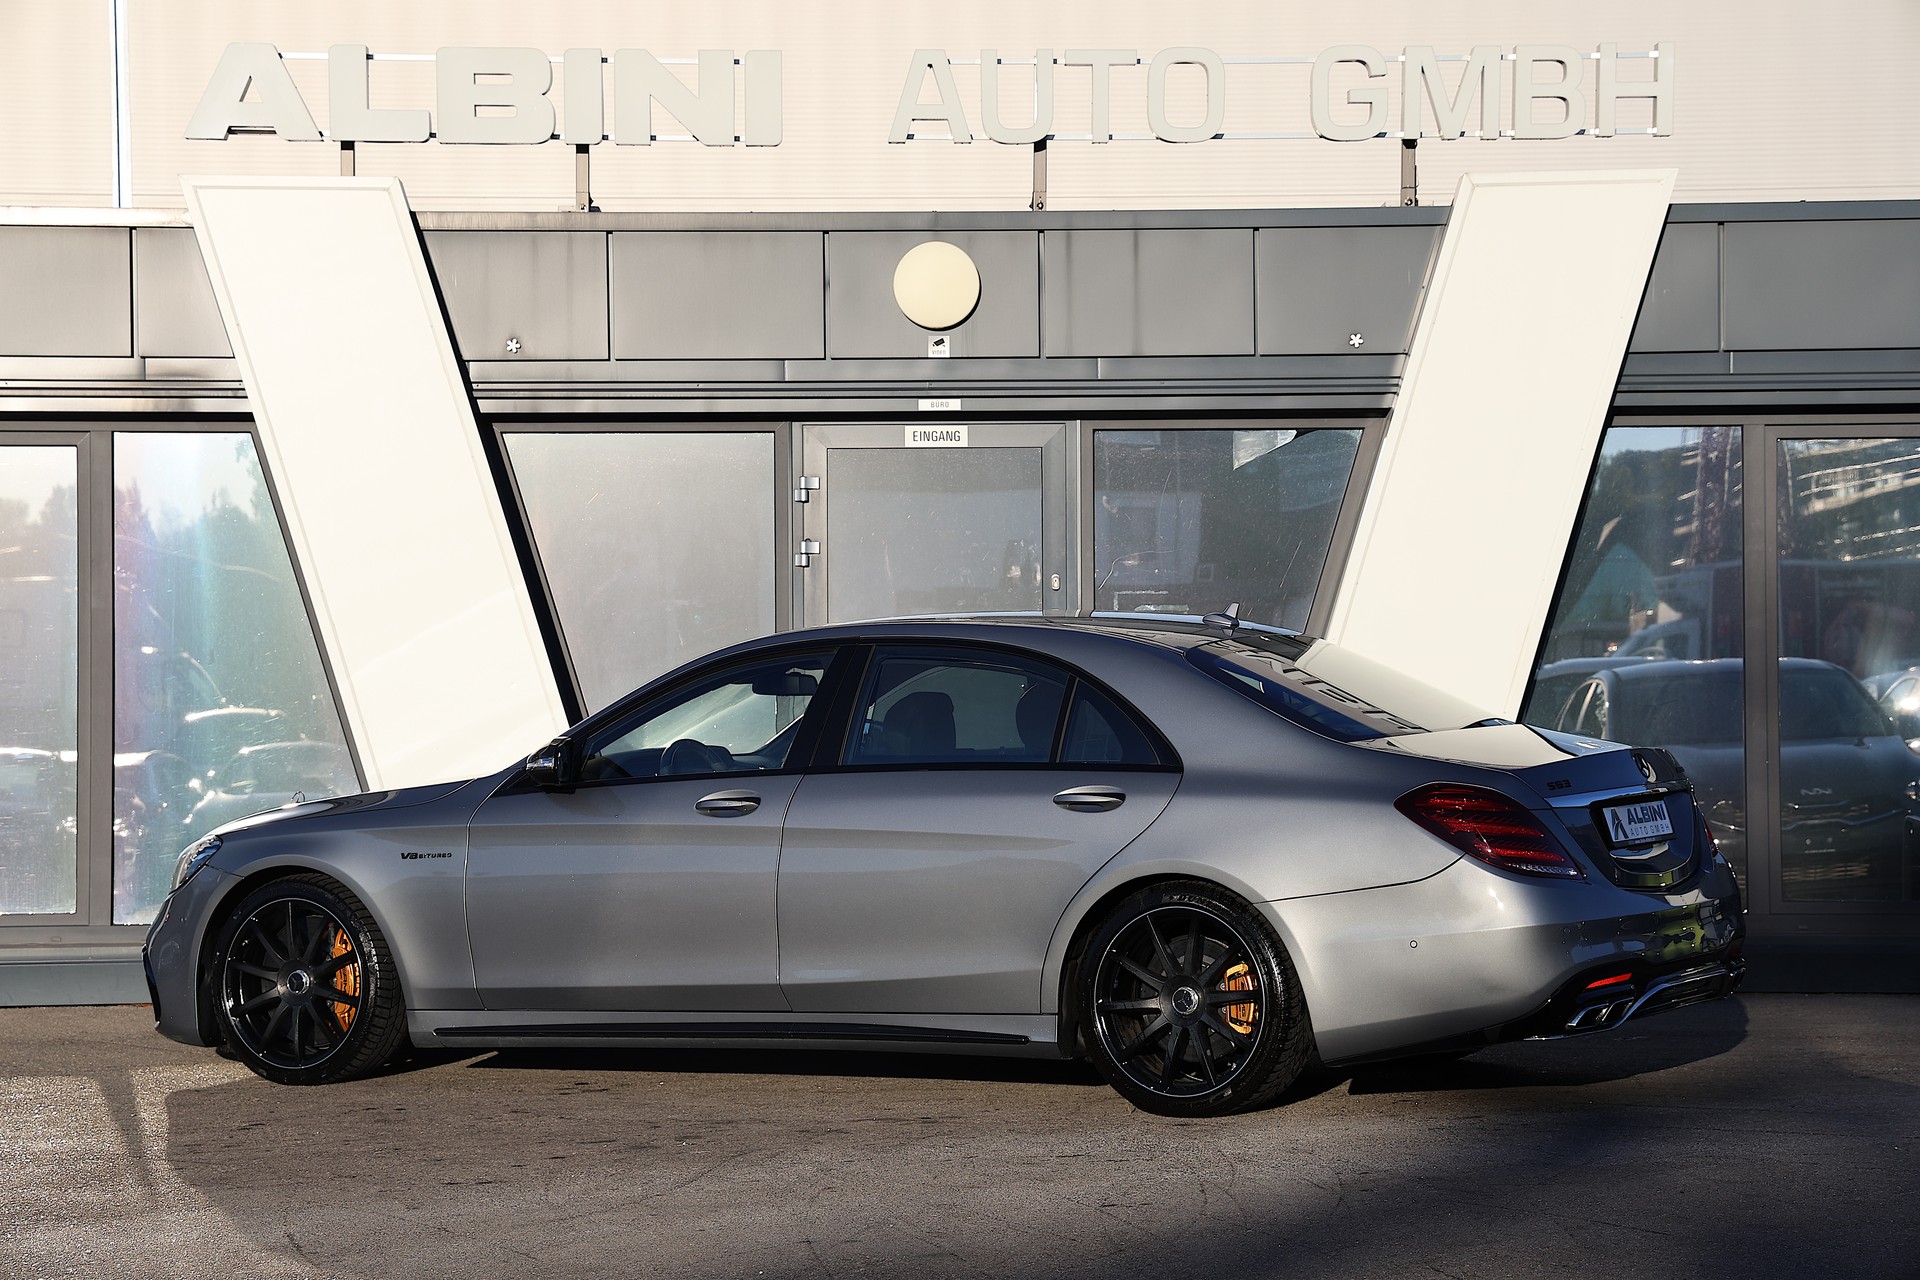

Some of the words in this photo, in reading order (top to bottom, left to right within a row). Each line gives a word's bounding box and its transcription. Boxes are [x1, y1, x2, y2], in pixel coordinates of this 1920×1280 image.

[185, 42, 783, 147] ALBINI
[887, 46, 1226, 145] AUTO
[1309, 41, 1676, 142] GMBH
[912, 430, 961, 442] EINGANG
[1627, 804, 1666, 825] ALBINI
[1630, 825, 1648, 837] AUTO
